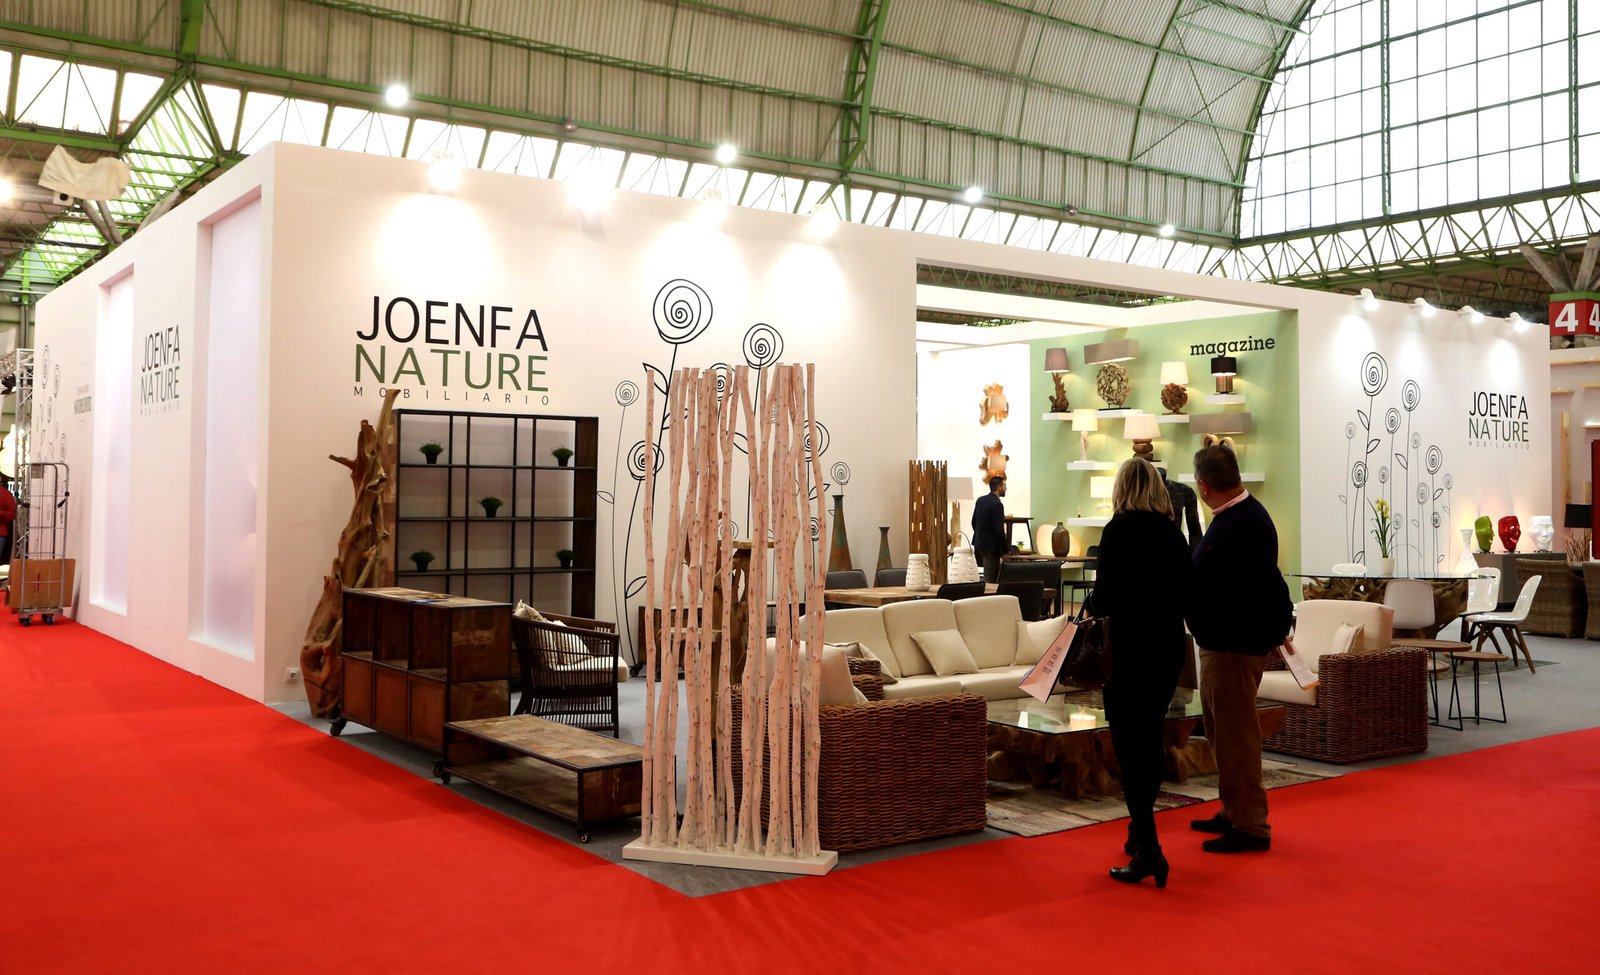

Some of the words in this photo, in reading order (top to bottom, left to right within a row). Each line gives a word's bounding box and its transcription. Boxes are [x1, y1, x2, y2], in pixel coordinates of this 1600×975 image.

[356, 296, 549, 351] JOENFA
[1555, 303, 1579, 332] 4
[142, 325, 180, 372] JOENFA
[1190, 336, 1276, 358] magazine
[355, 343, 549, 392] NATURE
[140, 366, 180, 405] NATURE
[353, 386, 549, 405] MOBILIARIO
[1469, 391, 1529, 420] JOENFA
[1469, 417, 1529, 442] NATURE
